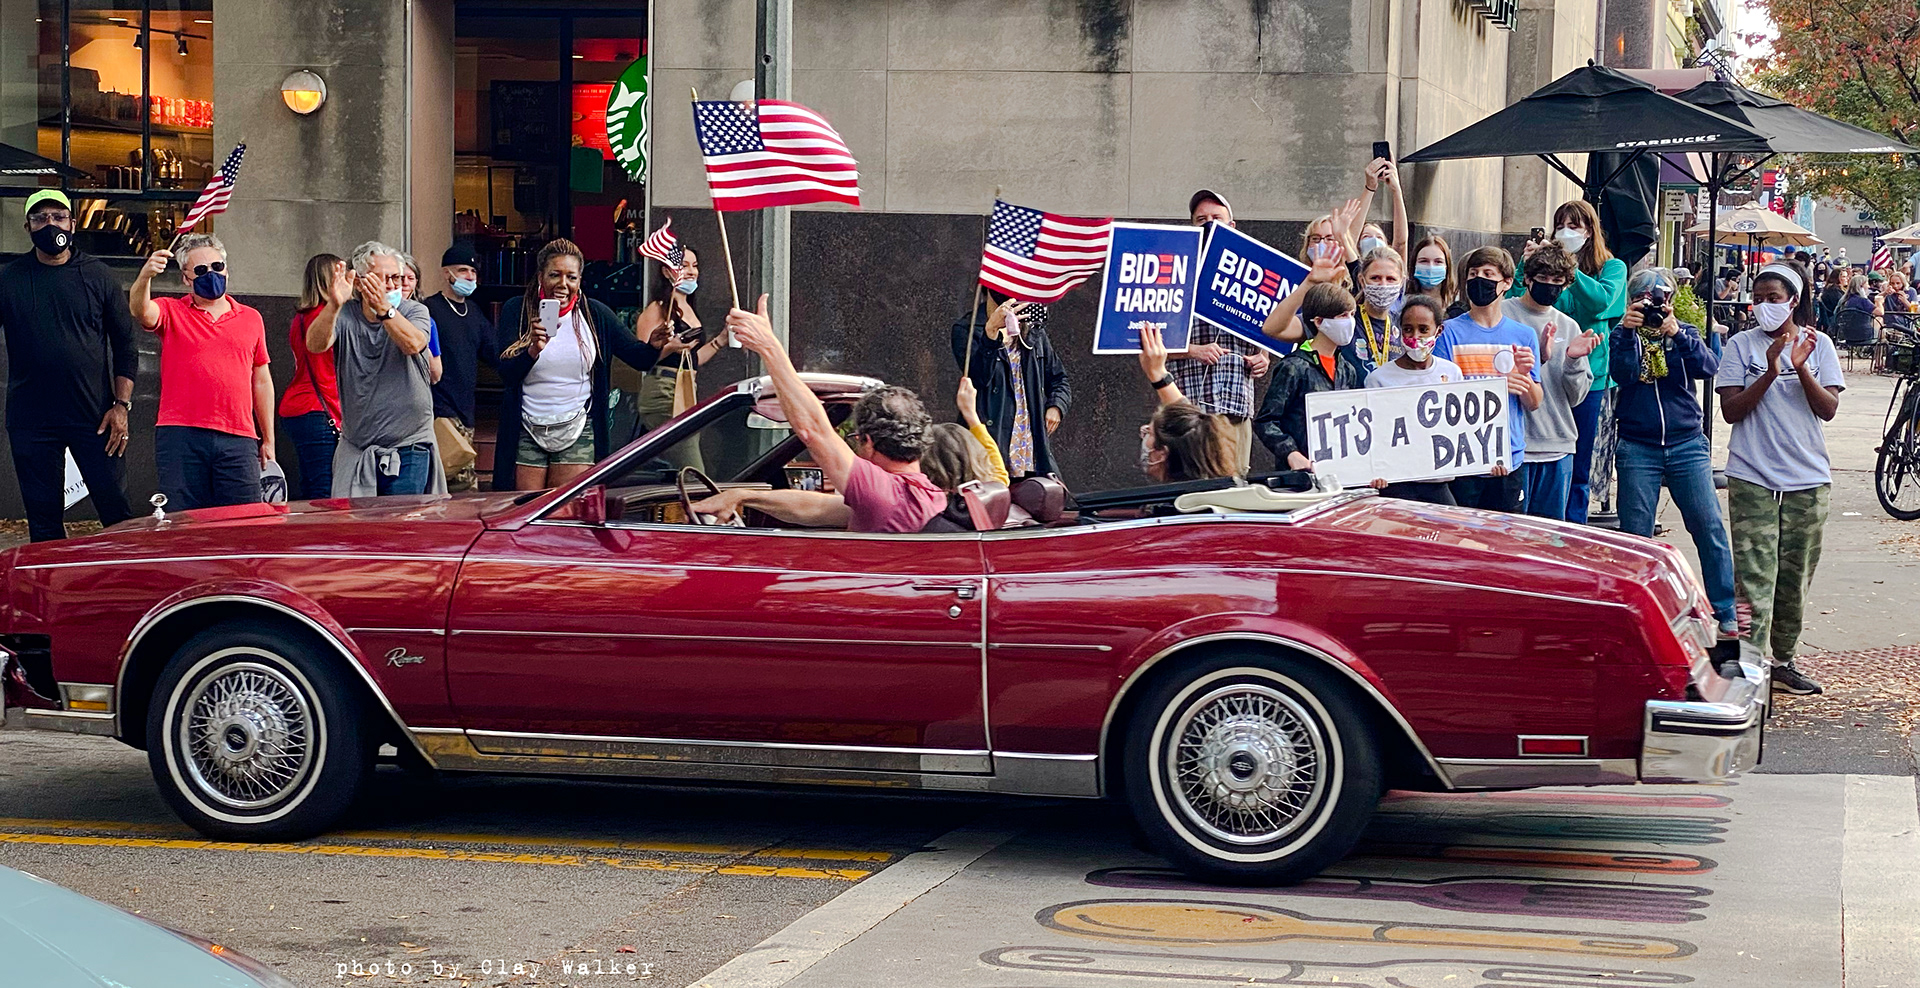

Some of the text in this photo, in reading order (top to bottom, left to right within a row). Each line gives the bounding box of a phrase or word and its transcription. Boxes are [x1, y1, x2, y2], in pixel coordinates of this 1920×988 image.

[1616, 134, 1719, 148] STARBUCKS
[1119, 252, 1189, 285] BIDEN
[1217, 248, 1299, 301] BIDEN
[1114, 287, 1185, 313] HARRIS
[1210, 272, 1280, 317] HARRI
[1211, 297, 1226, 310] Text
[1225, 304, 1252, 322] UNITED
[1251, 318, 1259, 326] to
[1312, 389, 1502, 463] IT'S A GOOD
[1431, 423, 1504, 471] DAY!
